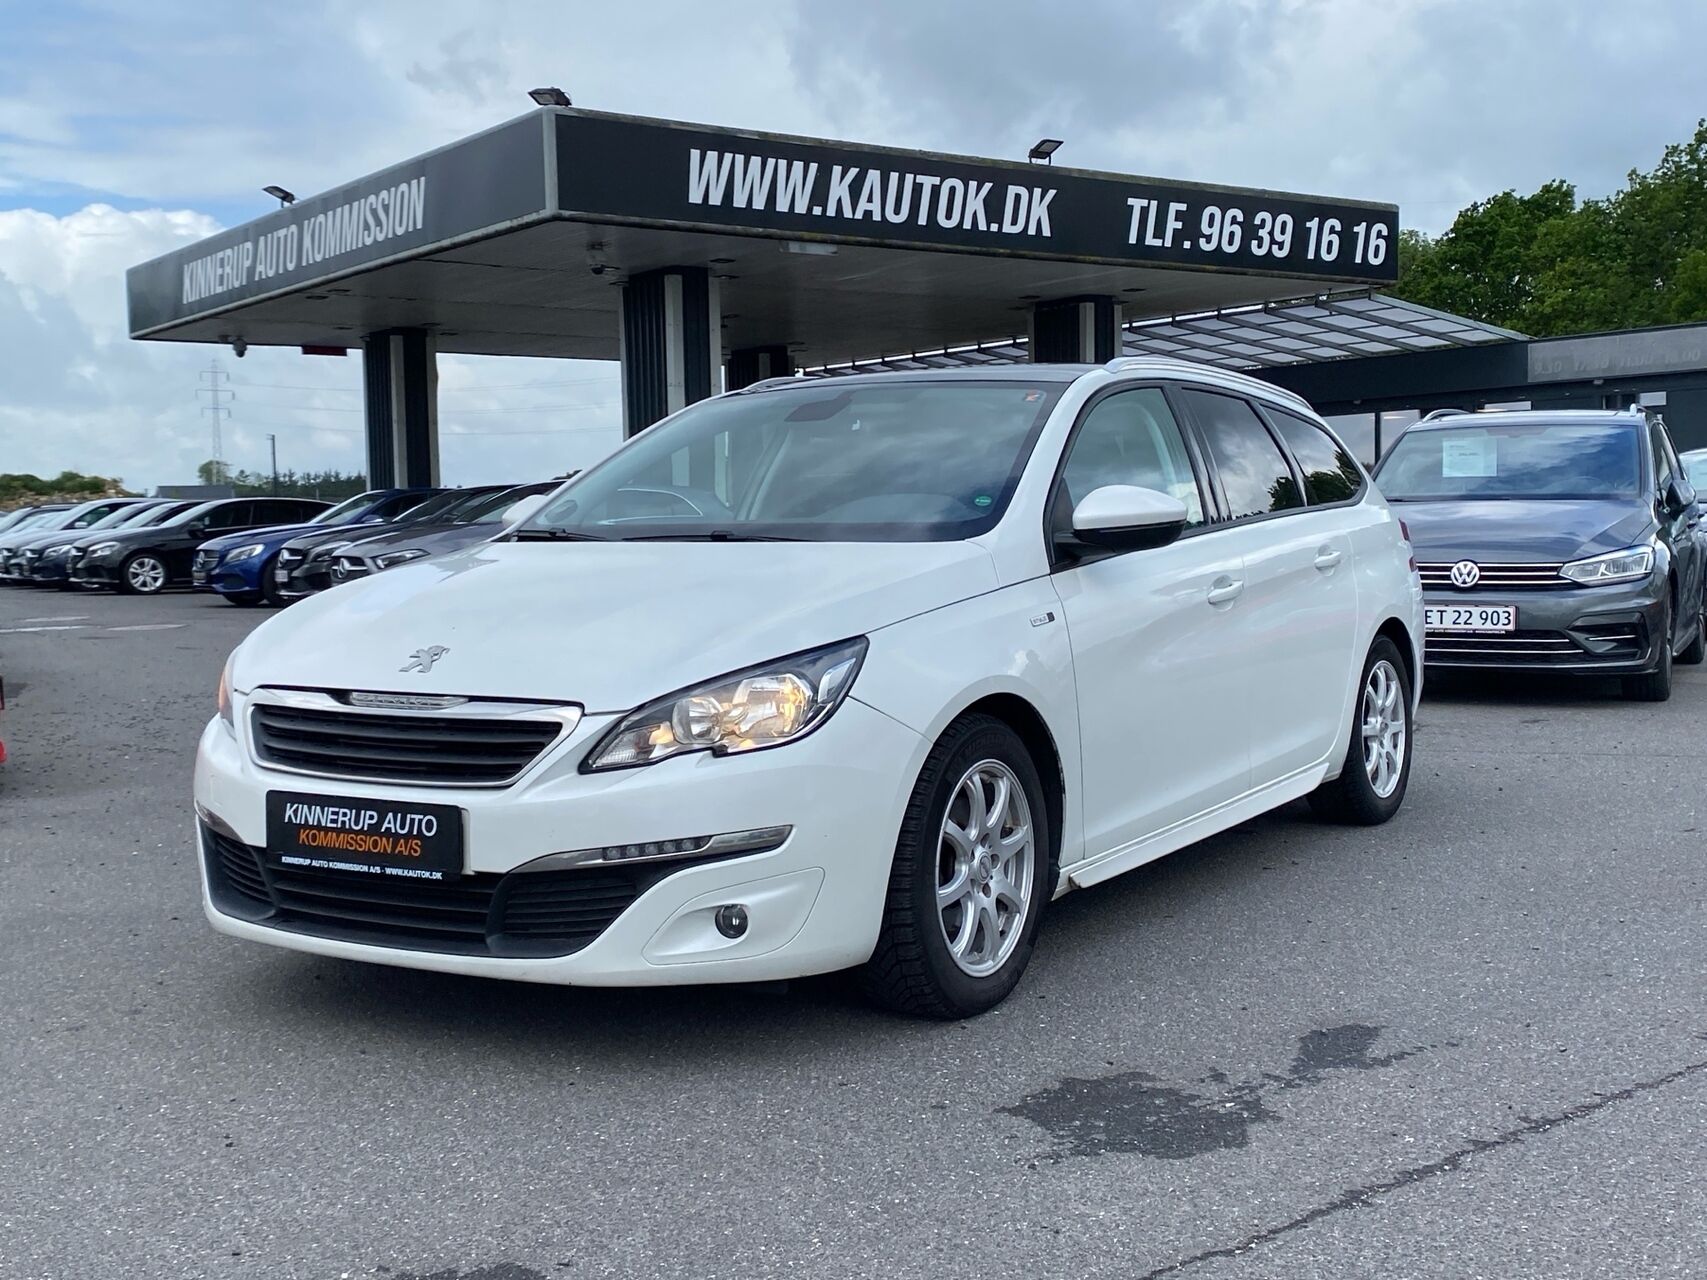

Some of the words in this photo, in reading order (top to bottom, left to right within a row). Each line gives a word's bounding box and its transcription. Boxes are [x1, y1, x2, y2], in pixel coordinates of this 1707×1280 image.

[688, 148, 1057, 238] WWW.KAUTOK.DK
[182, 241, 253, 304] KINNERUP
[254, 224, 299, 281] AUTO
[302, 176, 426, 266] KOMMISSION
[1127, 197, 1191, 249] TLF.
[1199, 205, 1244, 254] 96
[1251, 211, 1294, 258] 39
[1305, 217, 1342, 262] 16
[1353, 222, 1389, 266] 16
[1452, 562, 1478, 586] VW
[1425, 610, 1447, 625] ET
[1452, 610, 1473, 625] 22
[1479, 610, 1512, 626] 903
[284, 802, 378, 833] KINNERUP
[381, 812, 438, 837] AUTO
[299, 829, 393, 854] KOMMISSION
[395, 839, 422, 857] A/S
[281, 856, 311, 866] KINNERUP
[311, 860, 329, 868] AUTO
[329, 862, 369, 873] KOMMISSION
[369, 865, 381, 874] A/S
[385, 867, 443, 880] WWW.KAUTOK.DK
